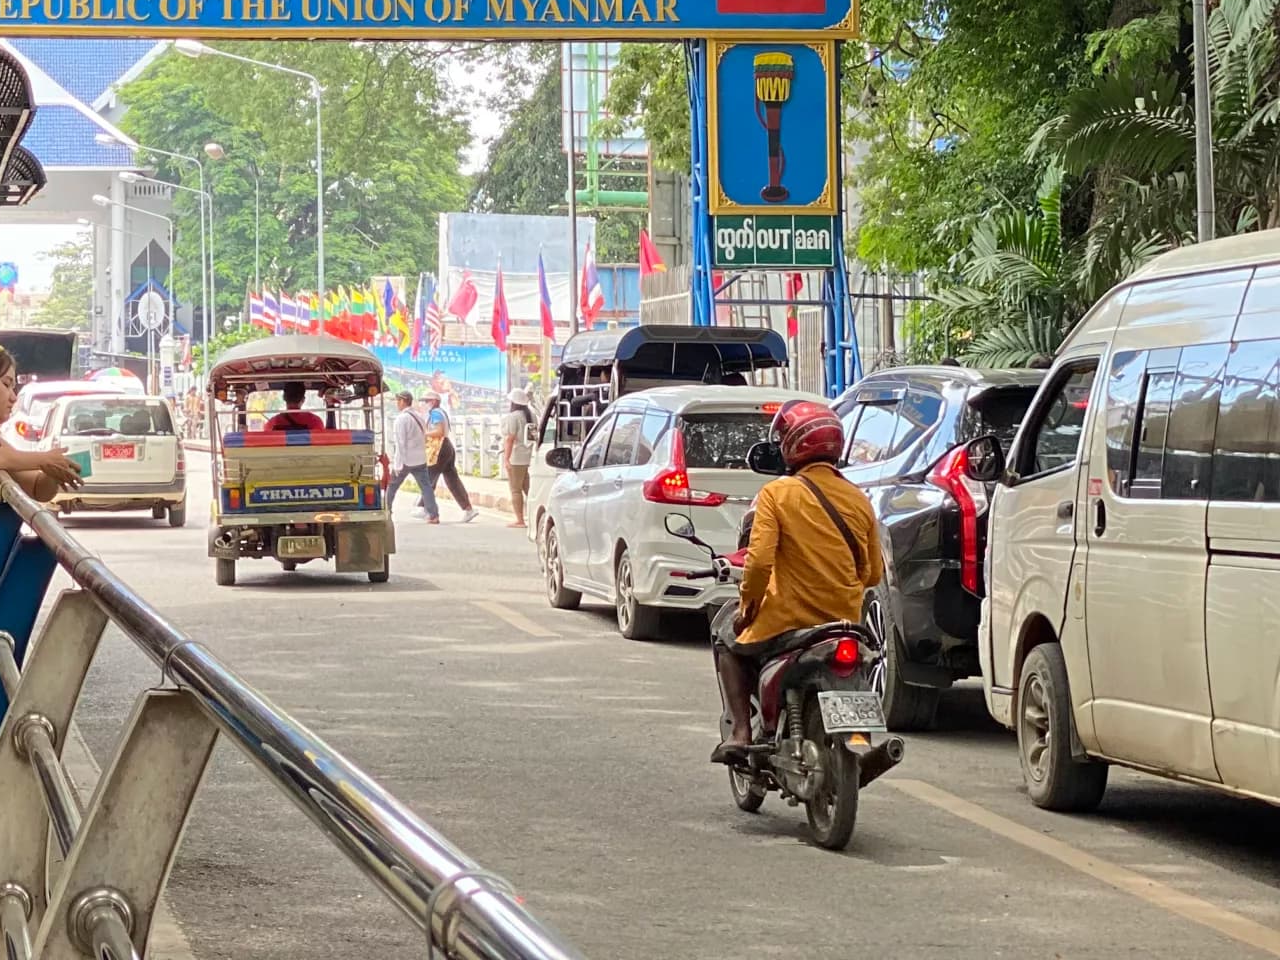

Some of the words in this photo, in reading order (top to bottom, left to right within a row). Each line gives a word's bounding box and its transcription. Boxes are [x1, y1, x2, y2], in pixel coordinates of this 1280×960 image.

[756, 228, 791, 250] OUT
[795, 228, 830, 250] ออก
[260, 486, 345, 500] THAILAND
